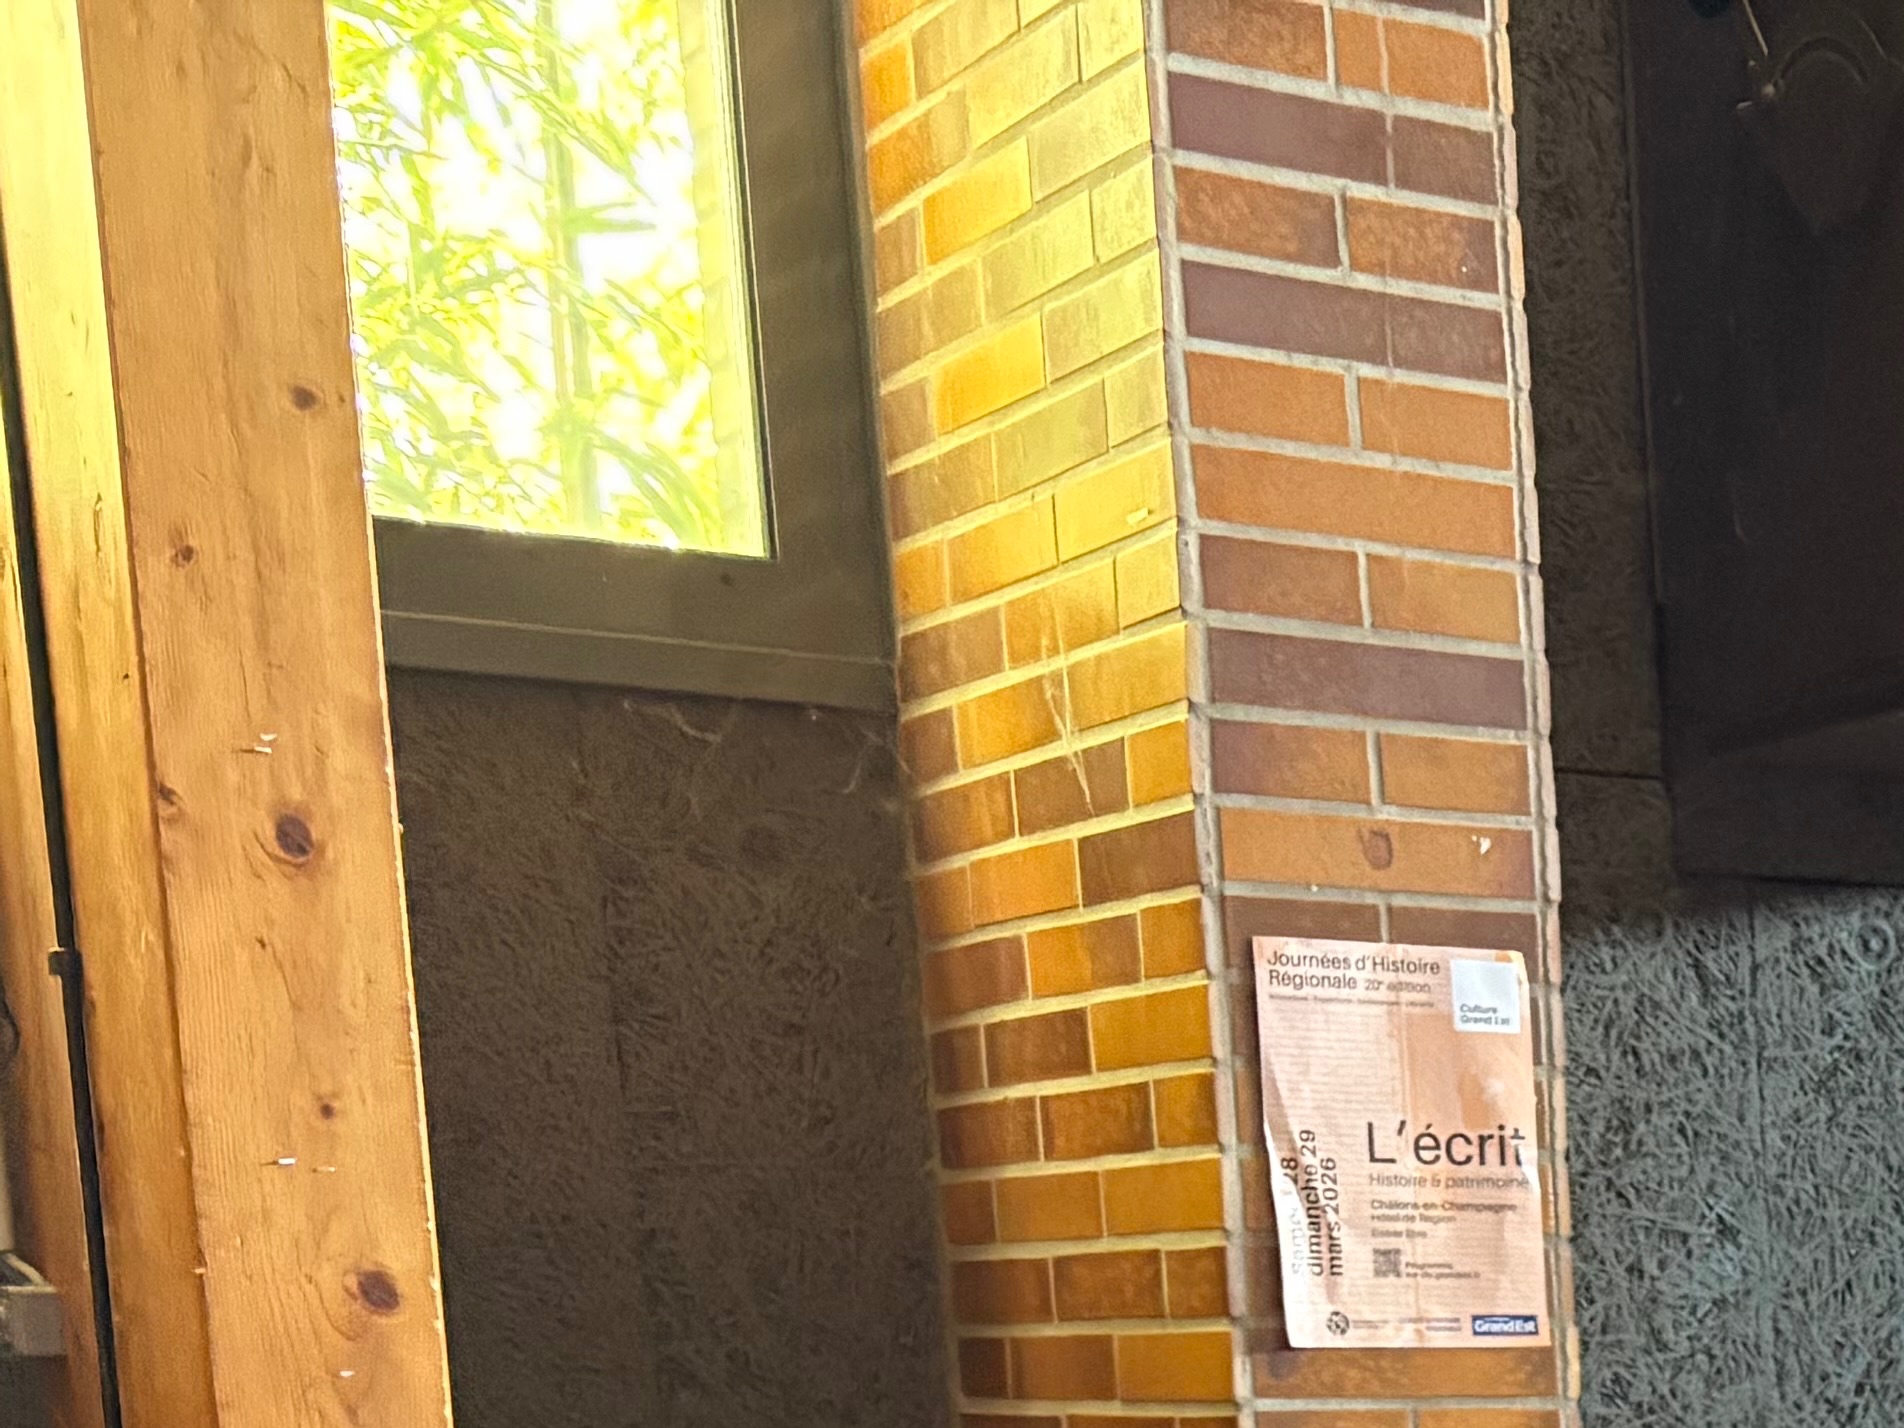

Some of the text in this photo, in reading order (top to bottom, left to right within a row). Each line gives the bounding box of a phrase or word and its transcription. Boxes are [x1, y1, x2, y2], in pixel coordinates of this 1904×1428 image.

[1267, 951, 1440, 975] Journées d'Histoire
[1269, 969, 1357, 991] Régionale
[1460, 1004, 1498, 1014] Culture
[1367, 1120, 1526, 1167] L'écrit
[1369, 1174, 1427, 1189] Histoire
[1300, 1129, 1324, 1276] dimanche 29
[1320, 1157, 1344, 1276] mars 2026
